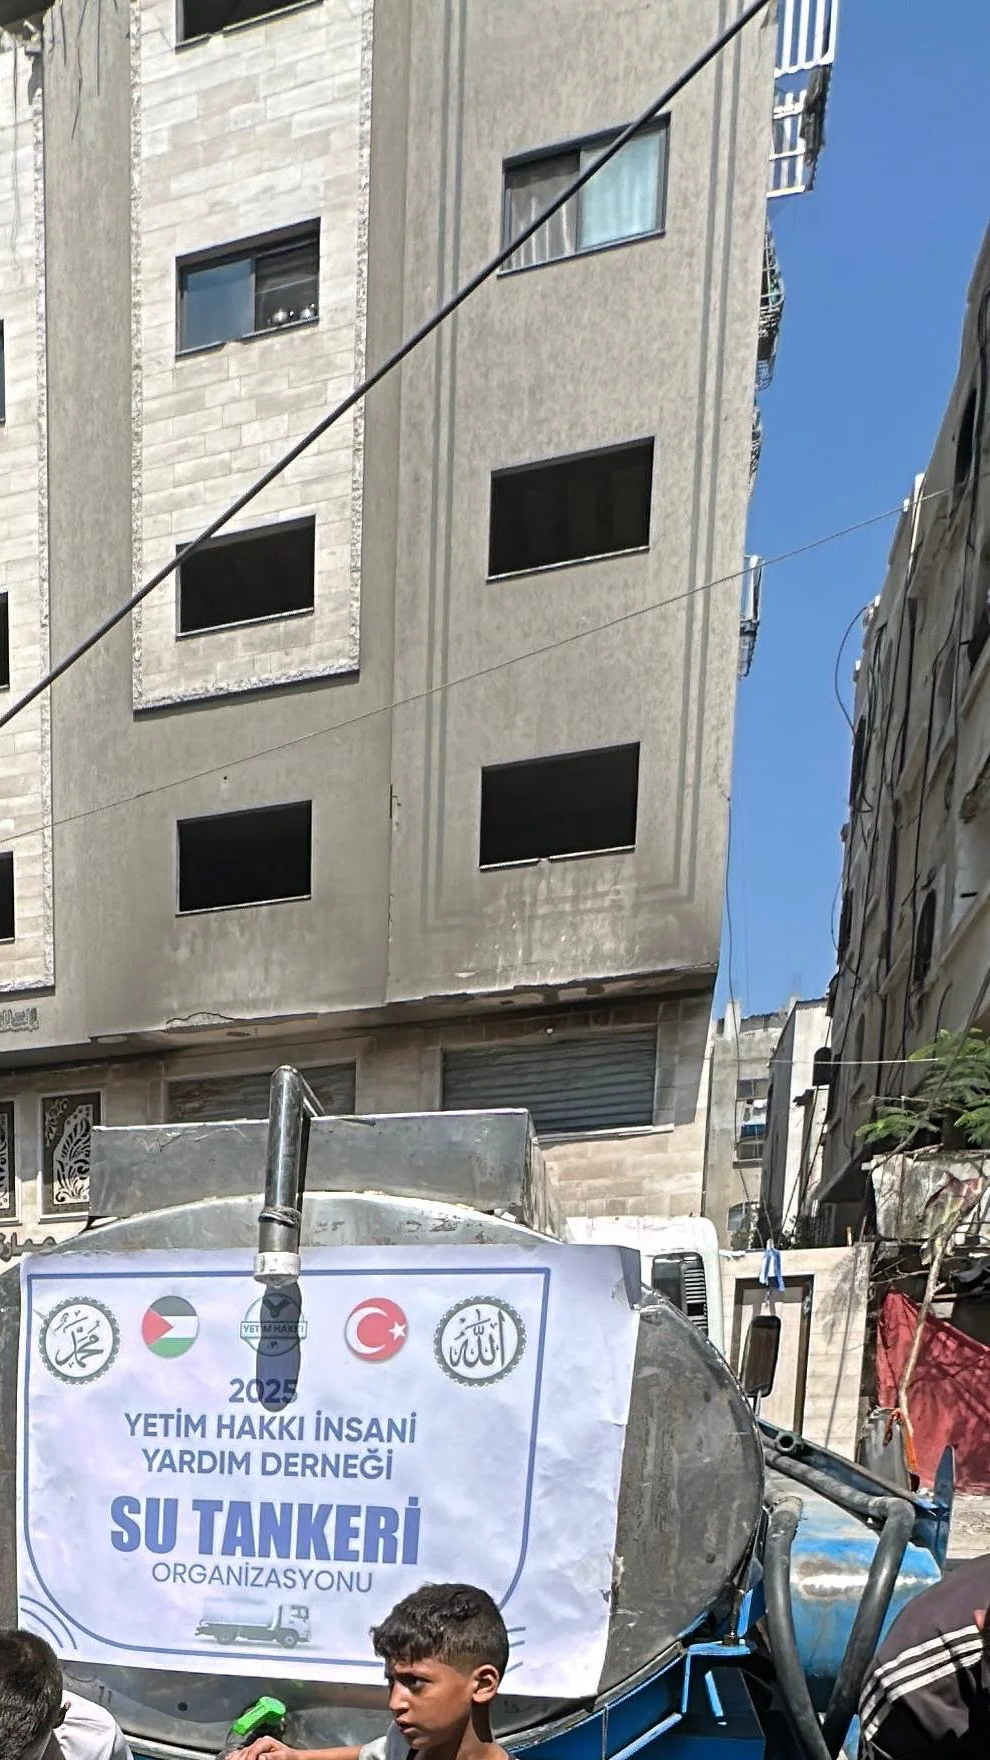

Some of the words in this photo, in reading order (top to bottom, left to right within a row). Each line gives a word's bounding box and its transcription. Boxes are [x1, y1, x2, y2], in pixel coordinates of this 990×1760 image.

[228, 1378, 298, 1404] 2025
[124, 1408, 207, 1439] YETİM
[216, 1414, 305, 1441] HAKKI
[314, 1410, 417, 1444] İNSANİ
[141, 1448, 251, 1476] YARDIM
[261, 1449, 393, 1480] DERNEĞİ
[111, 1495, 178, 1554] SU
[192, 1496, 421, 1565] TANKERİ
[152, 1562, 373, 1593] ORGANİZASYONU
